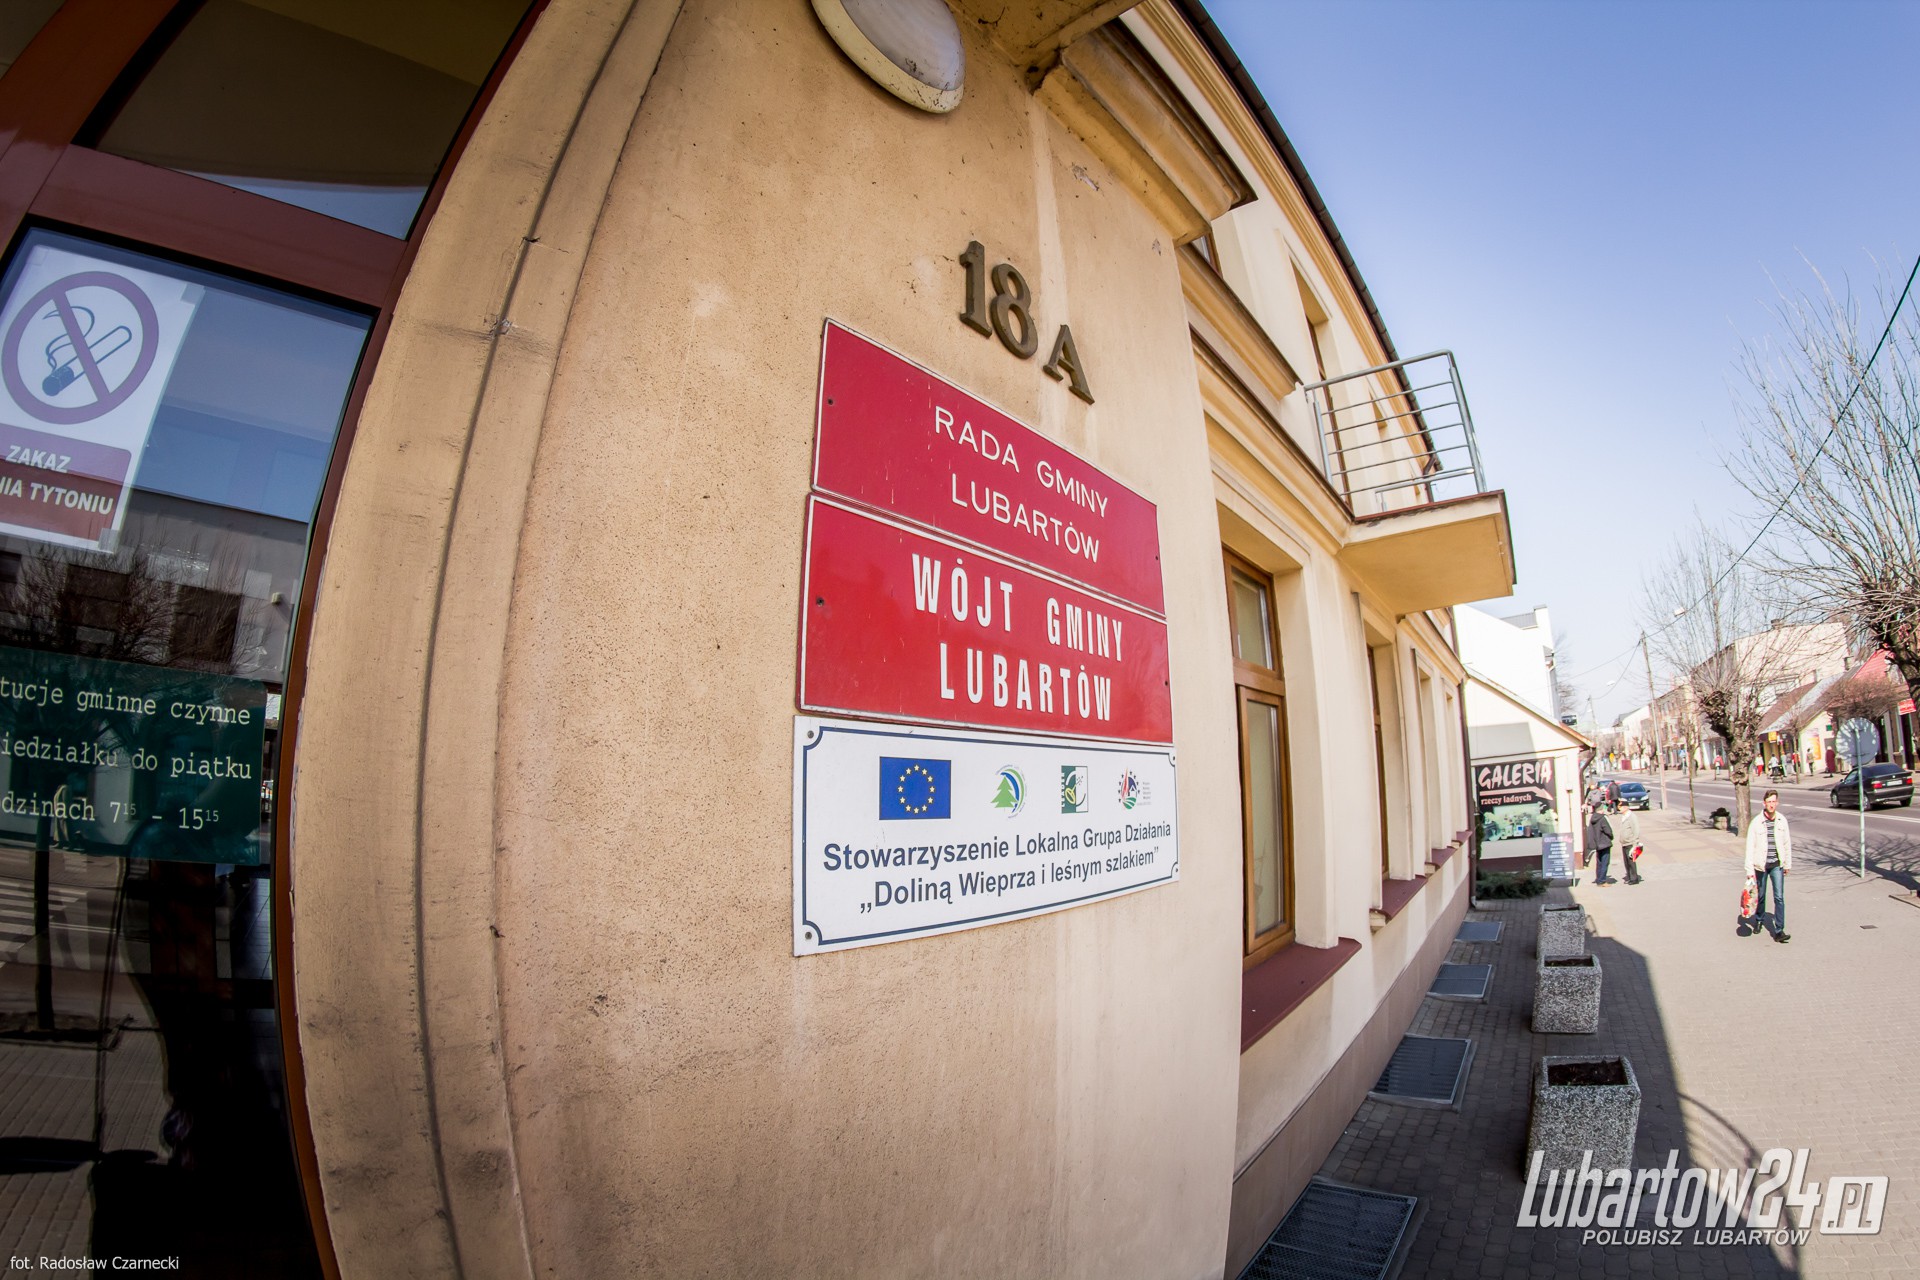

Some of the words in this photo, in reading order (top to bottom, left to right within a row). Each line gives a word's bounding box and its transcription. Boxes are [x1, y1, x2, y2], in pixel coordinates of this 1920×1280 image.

[5, 445, 71, 473] ZAKAZ
[935, 405, 1020, 473] RADA
[1036, 460, 1108, 518] GMINY
[30, 482, 114, 515] TYTONIU
[1046, 597, 1123, 662] GMINY
[0, 676, 63, 707] tucje
[77, 687, 157, 715] gminne
[171, 702, 250, 725] czynne
[0, 731, 118, 767] iedziałku
[132, 748, 158, 771] do
[170, 752, 251, 780] piątku
[1478, 760, 1552, 789] GALERIA
[1, 791, 96, 821] dzinach
[1481, 797, 1502, 806] rzeczy
[823, 836, 1009, 871] Stowarzyszenie
[1015, 826, 1079, 857] Lokalna
[1083, 827, 1122, 852] Grupa
[1125, 821, 1171, 841] Działania
[860, 878, 953, 915] „Doliną
[958, 869, 1036, 898] Wieprza
[1041, 864, 1046, 884] i
[1051, 857, 1102, 884] leśnym
